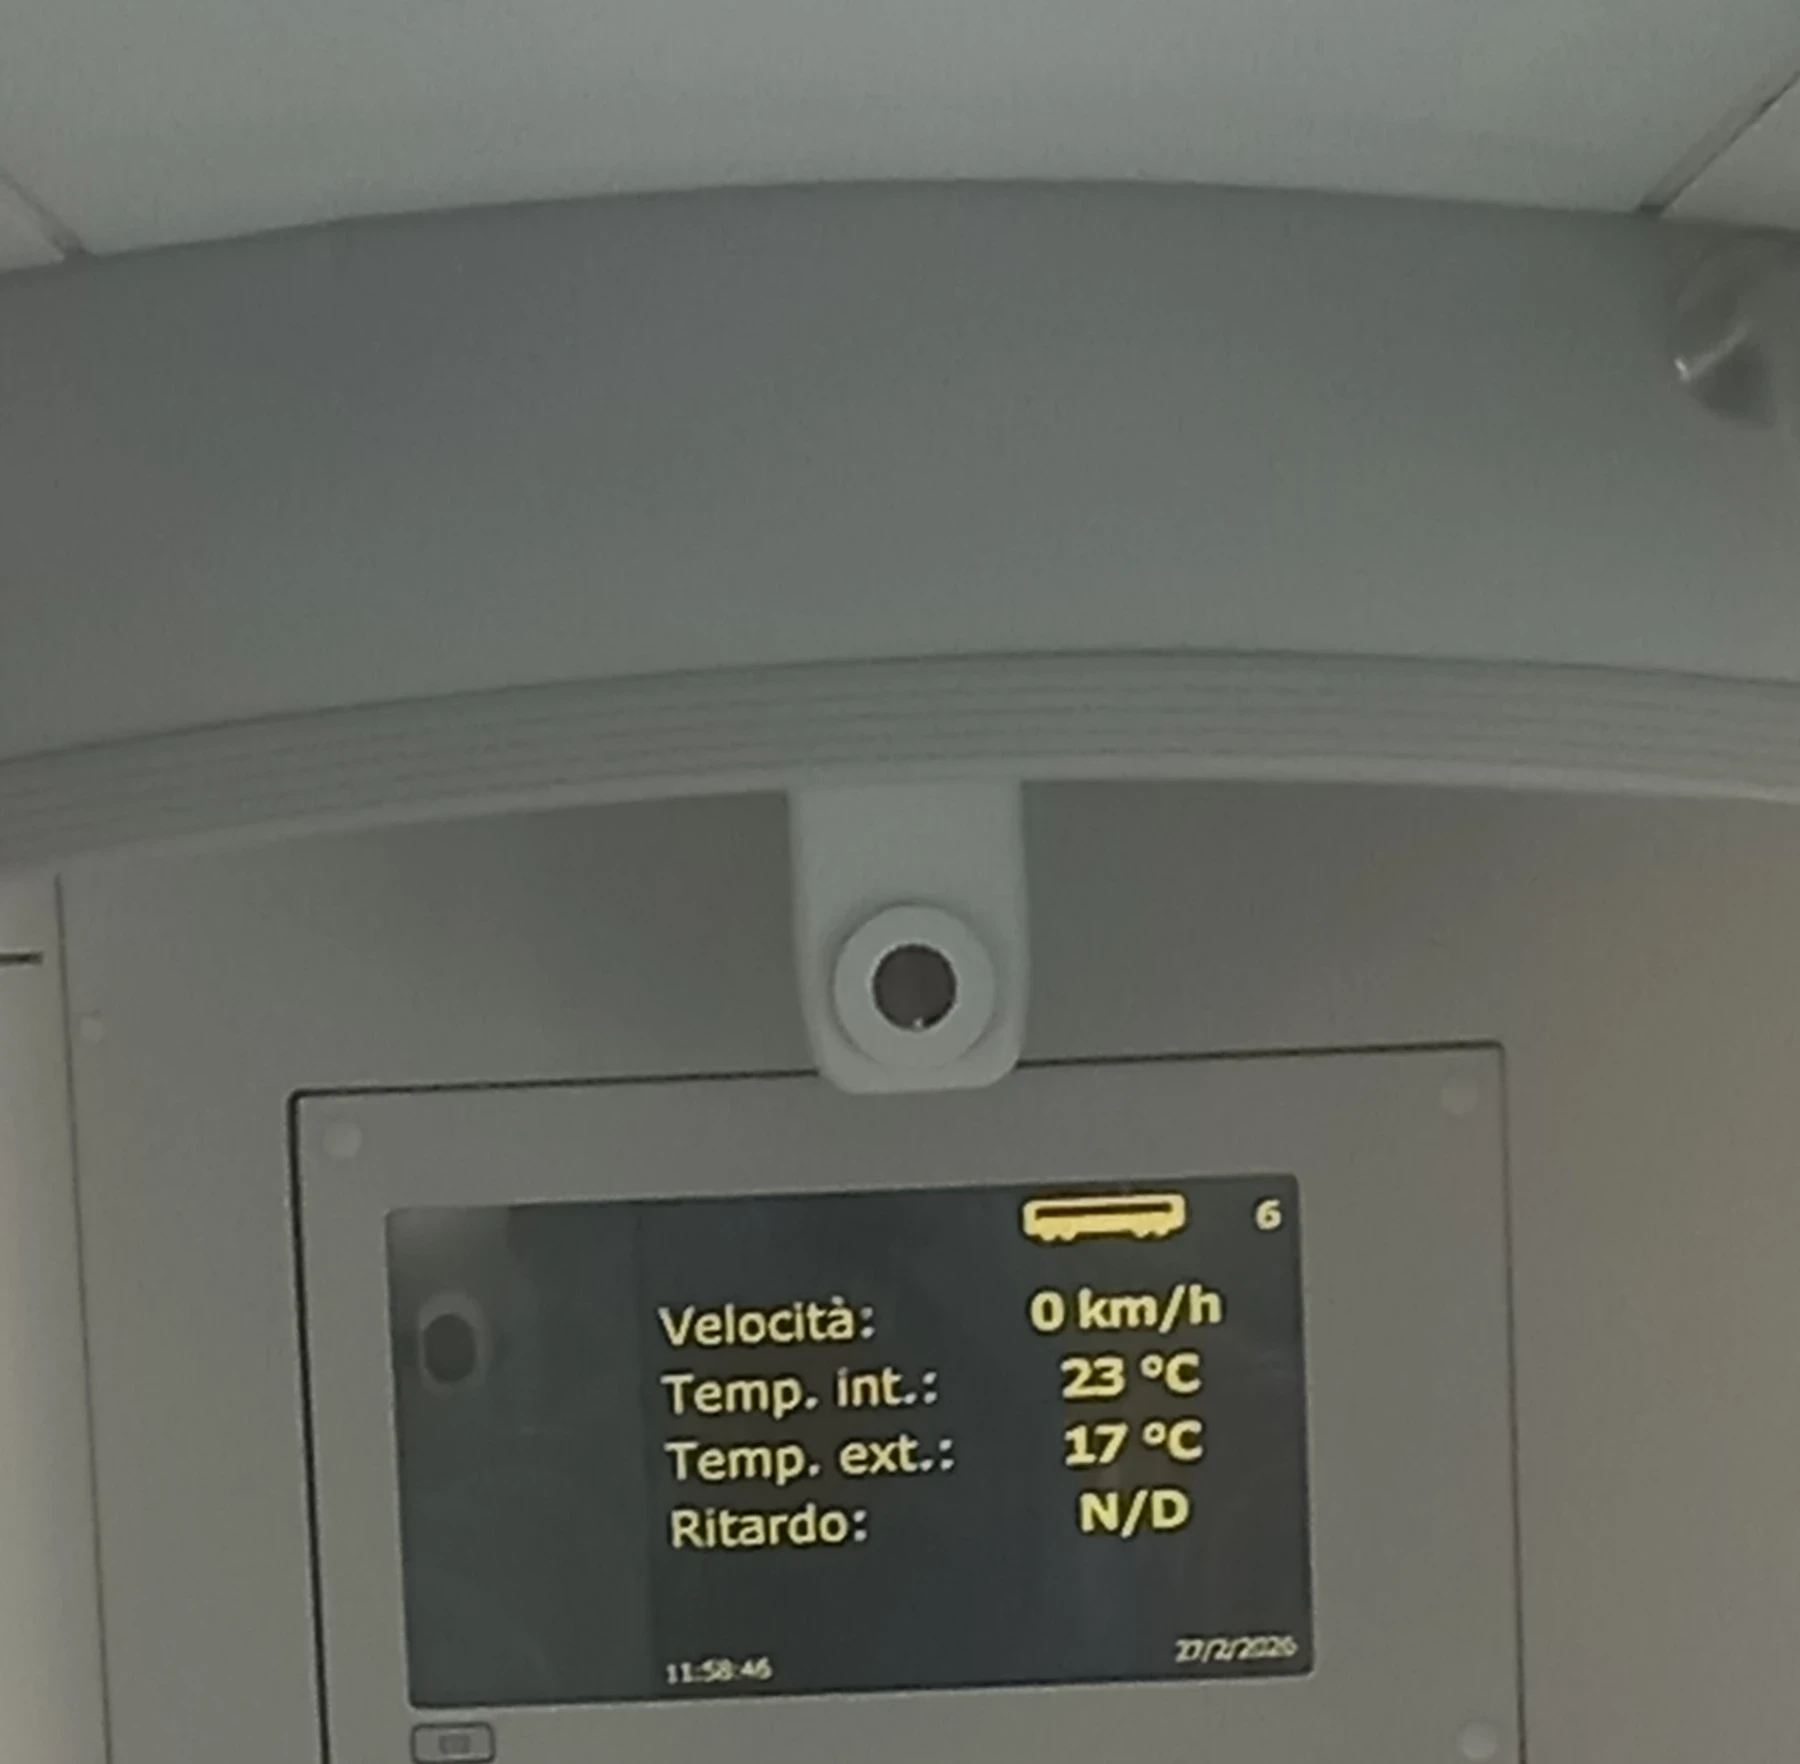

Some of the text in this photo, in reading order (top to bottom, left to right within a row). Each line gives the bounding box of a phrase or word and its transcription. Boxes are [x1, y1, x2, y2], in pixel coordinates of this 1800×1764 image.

[1255, 1199, 1282, 1231] 6
[657, 1283, 1223, 1346] Velocità: 0 km/h
[660, 1352, 1201, 1421] Temp. int.: 23 °C
[663, 1419, 1204, 1487] Temp. ext.: 17 °C
[670, 1489, 1190, 1549] Ritardo: N/D
